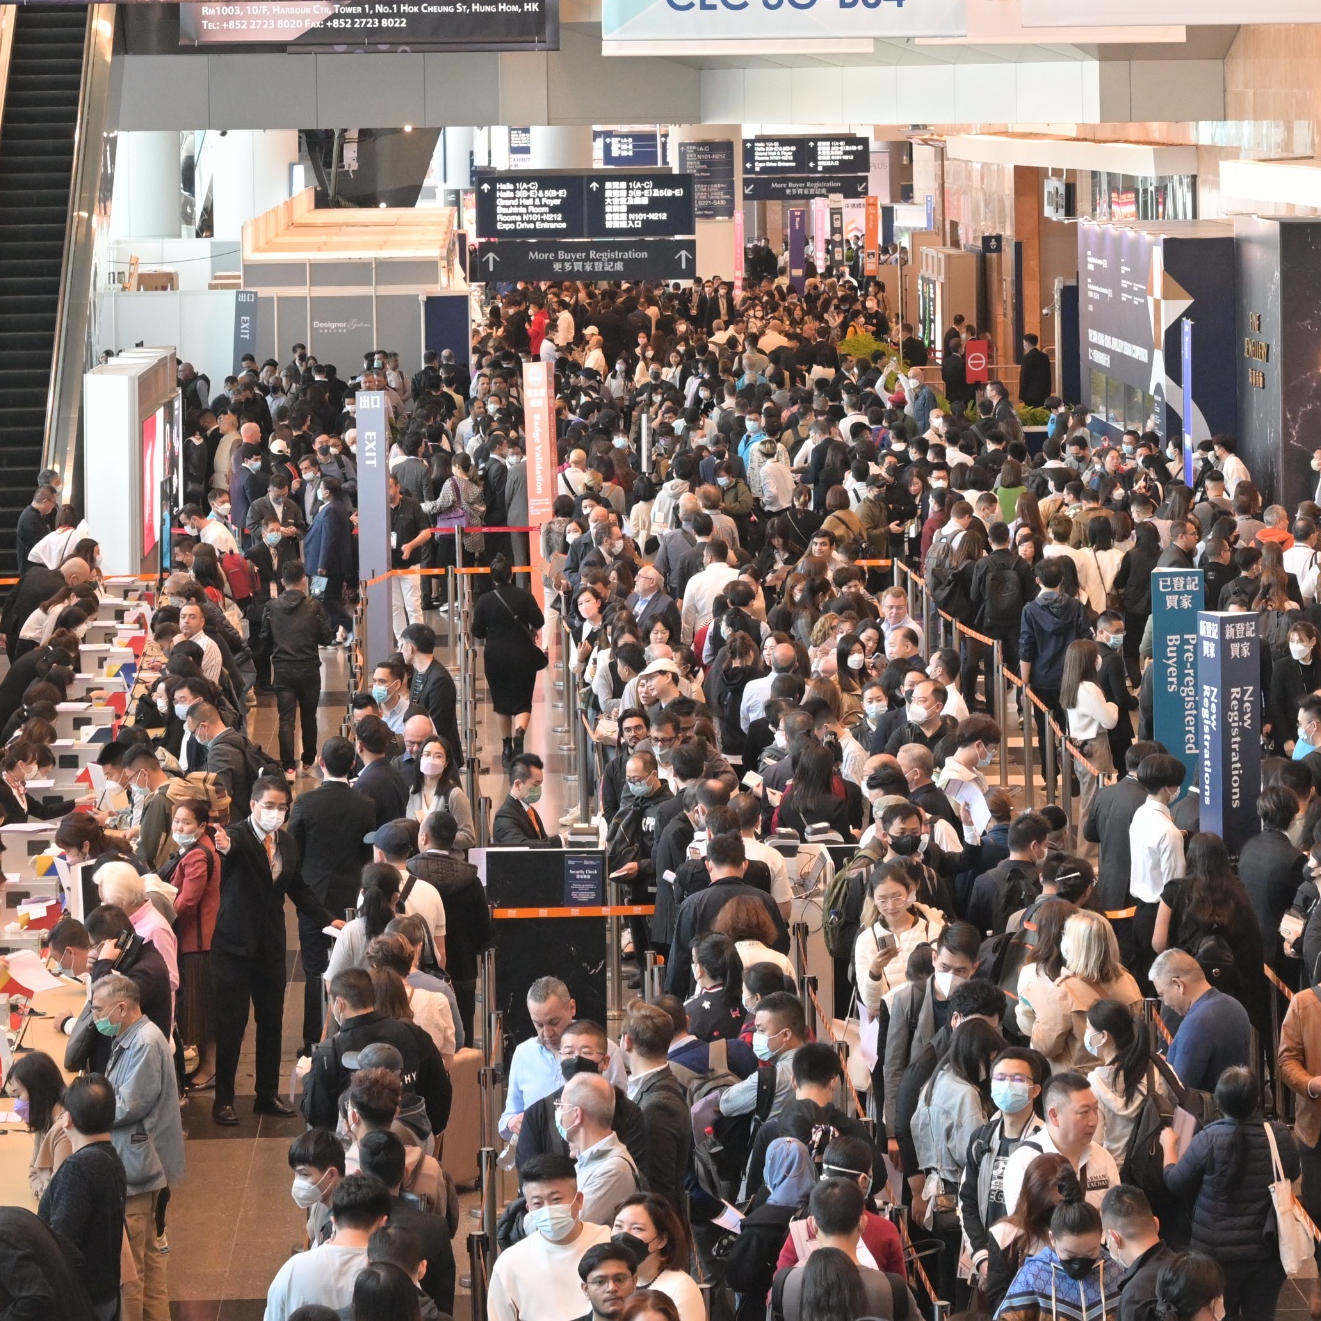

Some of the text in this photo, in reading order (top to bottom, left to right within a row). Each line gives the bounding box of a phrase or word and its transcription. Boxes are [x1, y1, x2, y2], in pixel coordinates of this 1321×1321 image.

[496, 190, 514, 198] Halls
[516, 181, 538, 190] 1(A-C)
[523, 213, 562, 221] N101-N212
[628, 212, 668, 220] N101-N212
[497, 222, 515, 230] Expo
[536, 221, 566, 229] Entrance
[528, 248, 648, 262] More Buyer Registration
[553, 262, 624, 272] 更多買家登記處
[238, 293, 255, 302] 出口
[240, 316, 250, 340] EXIT
[313, 320, 347, 329] Designer
[359, 395, 380, 409] 出口
[532, 413, 542, 443] Badge
[364, 431, 377, 467] EXIT
[534, 445, 545, 494] Validation
[1158, 576, 1199, 592] 已登記
[1165, 594, 1193, 609] 買家
[1200, 620, 1219, 639] 新登記
[1225, 621, 1256, 640] 新登記
[1203, 640, 1216, 659] 買家
[1230, 641, 1251, 659] 買家
[1166, 634, 1180, 693] Buyers
[1180, 634, 1200, 754] Pre-registered
[1209, 686, 1218, 731] New
[1243, 686, 1254, 729] New
[1202, 685, 1211, 806] Registrations
[1228, 687, 1241, 809] Registrations
